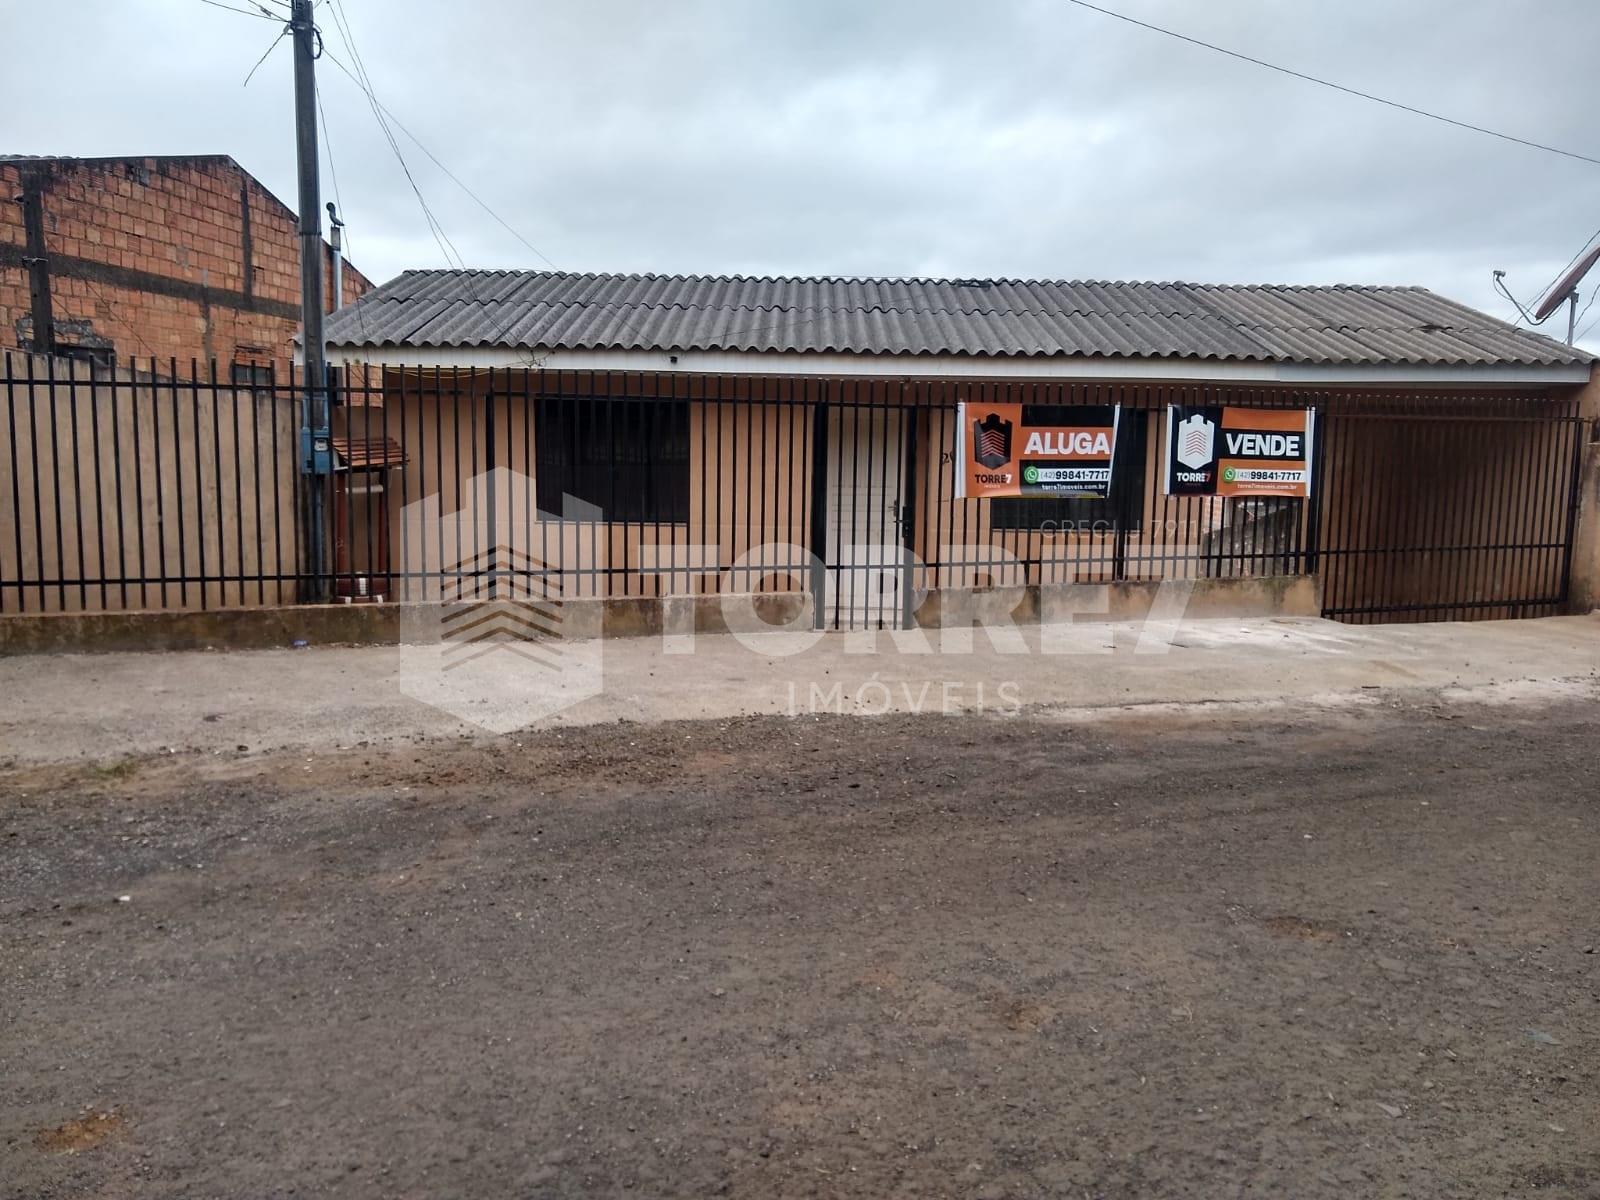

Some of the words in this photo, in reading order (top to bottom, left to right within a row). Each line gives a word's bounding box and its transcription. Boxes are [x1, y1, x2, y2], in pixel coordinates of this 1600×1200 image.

[1023, 432, 1110, 455] ALUGA
[1226, 433, 1300, 457] VENDE
[975, 473, 1012, 484] TORRE7
[1176, 471, 1212, 482] TORRE7
